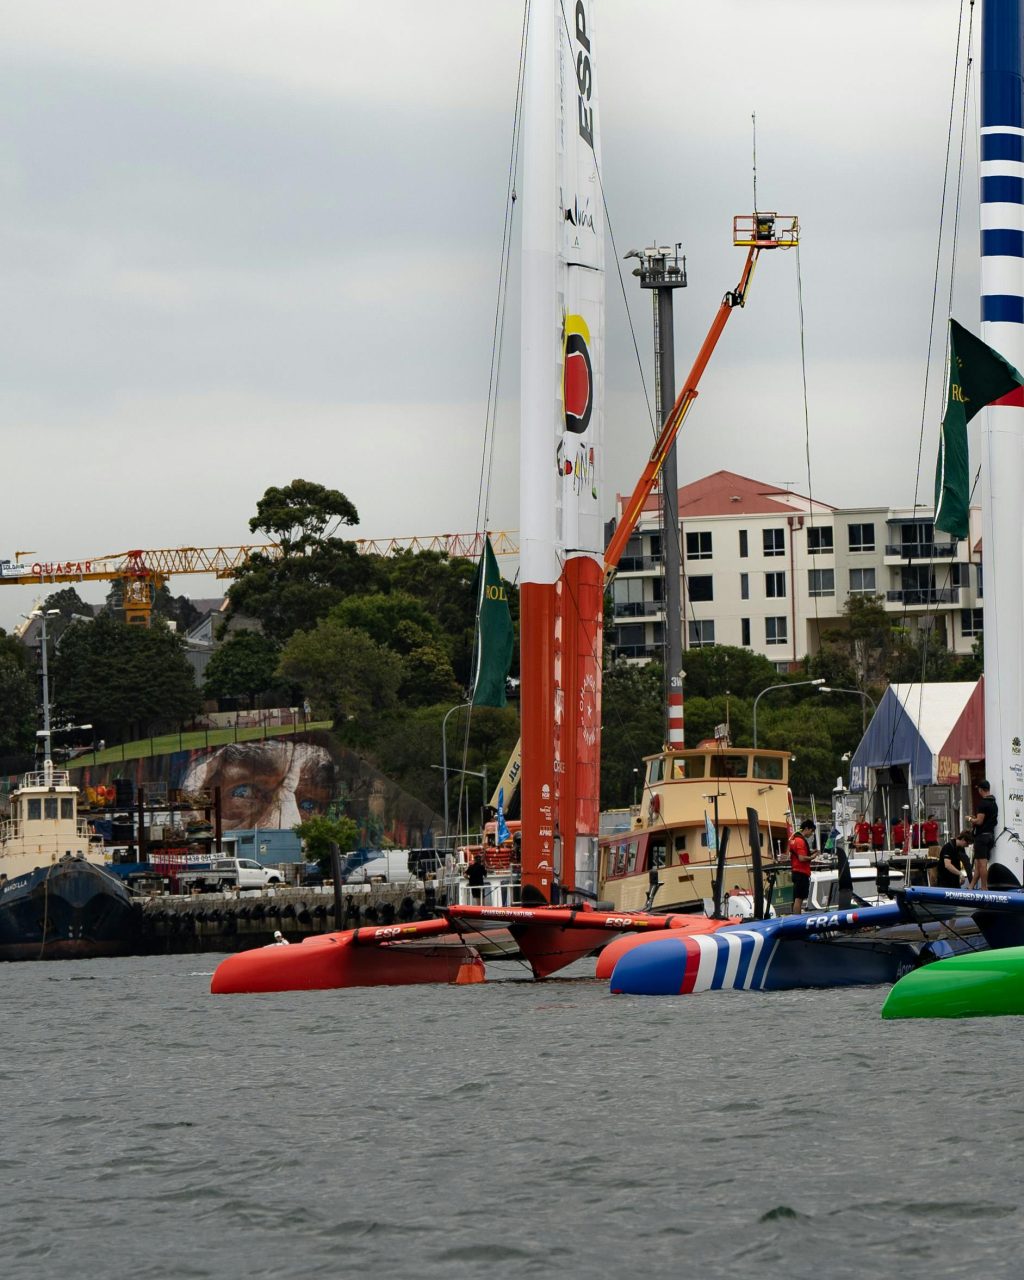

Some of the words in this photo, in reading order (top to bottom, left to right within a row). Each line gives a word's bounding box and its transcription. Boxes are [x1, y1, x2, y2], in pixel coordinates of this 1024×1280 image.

[575, 0, 594, 150] ESP
[31, 561, 92, 576] QUASAR
[508, 761, 521, 784] JLG
[1008, 793, 1024, 802] KPMG
[944, 890, 975, 900] POWERED
[975, 893, 984, 901] BY
[605, 917, 632, 928] ESP
[805, 914, 840, 930] FRA
[374, 927, 402, 939] ESP
